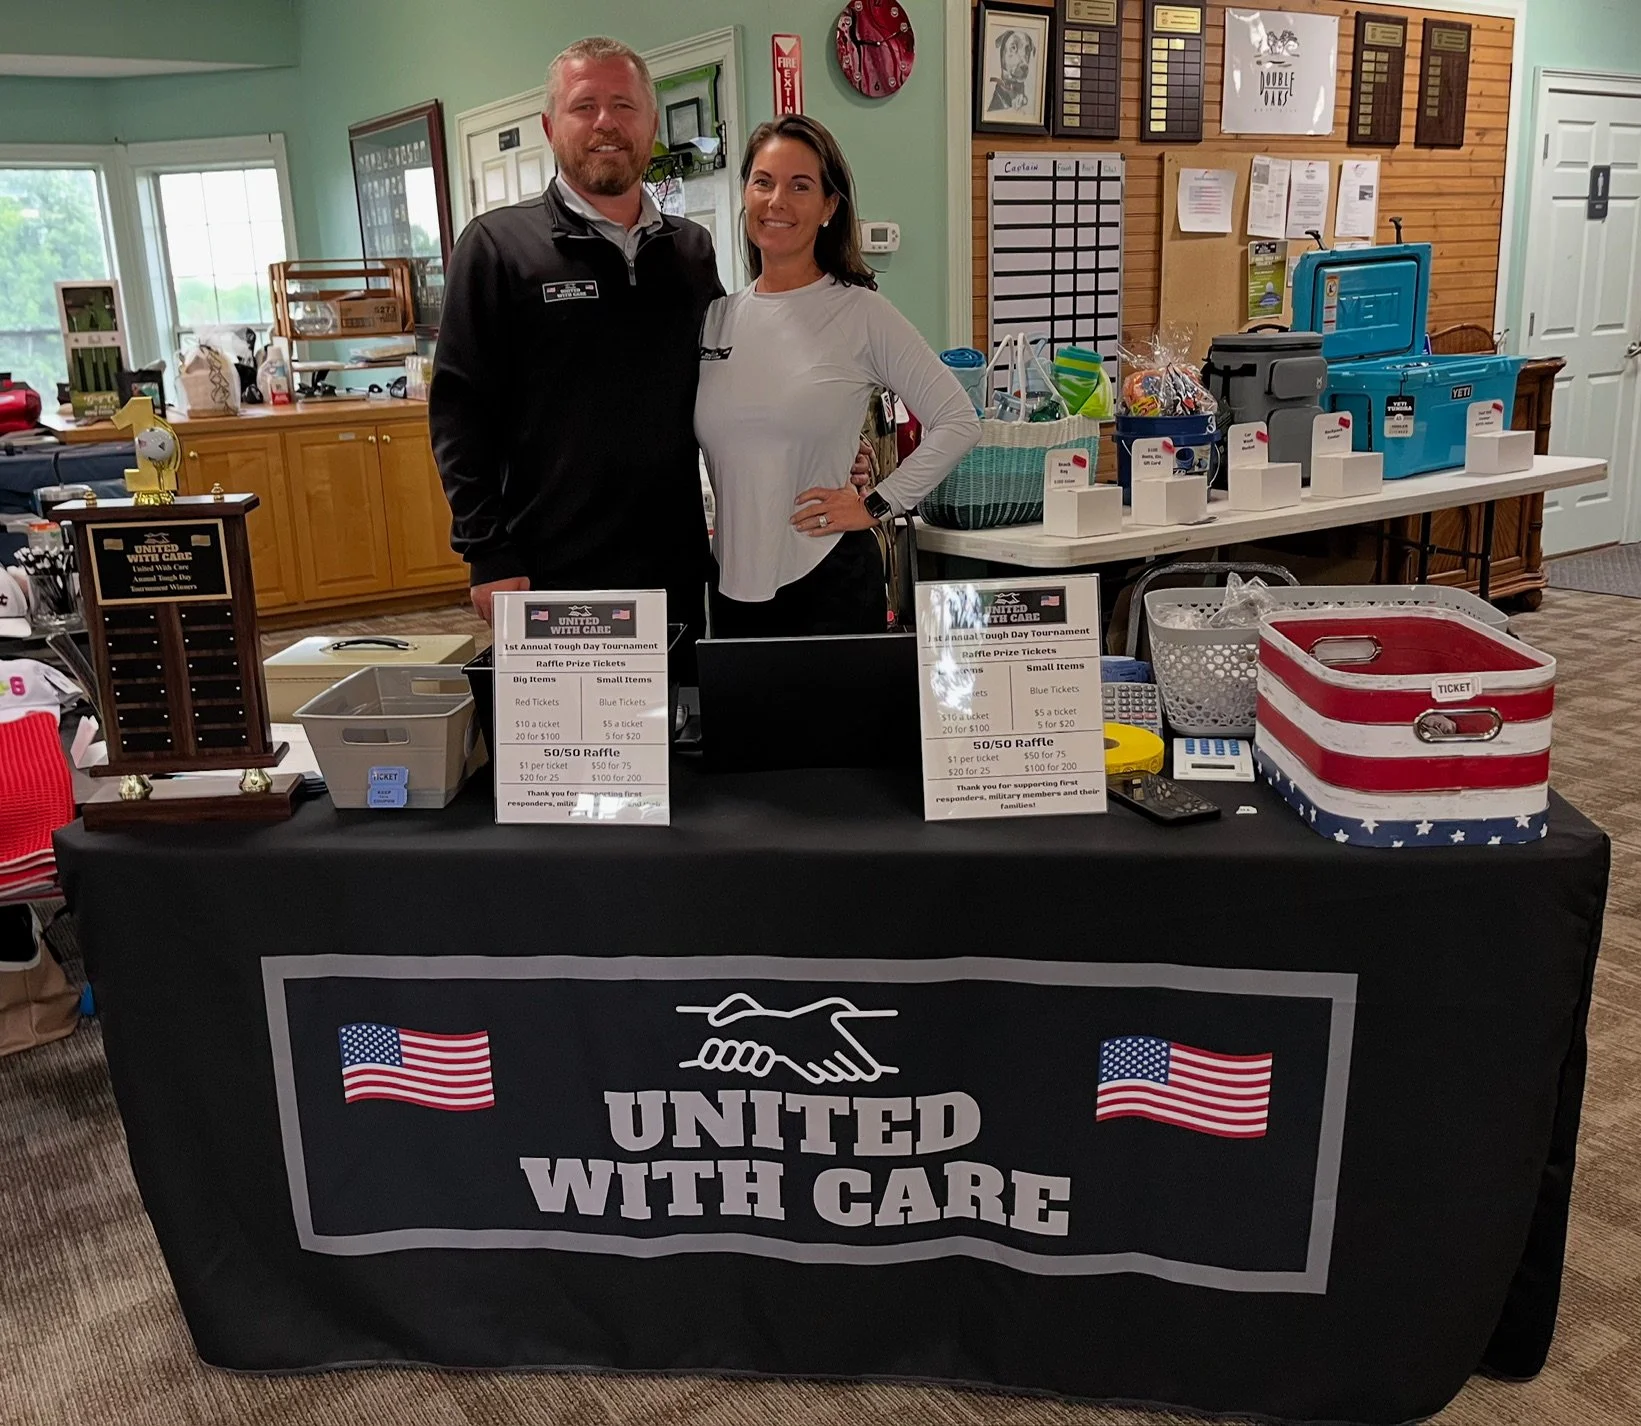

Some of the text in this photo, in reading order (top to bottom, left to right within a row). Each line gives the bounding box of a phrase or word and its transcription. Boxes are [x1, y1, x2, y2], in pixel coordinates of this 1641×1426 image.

[778, 56, 797, 68] FIRE
[874, 82, 880, 91] 6
[1260, 71, 1295, 96] DOUBLE
[1264, 90, 1289, 106] OAKS
[1004, 161, 1039, 174] Captain
[1452, 386, 1471, 398] YETI
[134, 543, 180, 554] UNITED
[126, 552, 193, 563] WITH CARE
[156, 564, 173, 572] With
[158, 574, 178, 582] Tough
[178, 574, 192, 582] Day
[984, 604, 1028, 614] UNITED
[558, 617, 600, 626] UNITED
[1010, 613, 1040, 622] CARE
[550, 626, 612, 635] WITH CARE
[944, 632, 978, 642] Annual
[980, 632, 1010, 640] Tough
[1011, 630, 1029, 640] Day
[1031, 628, 1090, 637] Tournament
[554, 643, 581, 651] Tough
[583, 642, 600, 651] Day
[602, 642, 658, 650] Tournament
[962, 647, 1057, 658] Raffle Prize Tickets
[536, 660, 564, 668] Raffle
[566, 660, 591, 668] Prize
[1026, 662, 1084, 672] Small Items
[513, 676, 528, 684] Big
[596, 676, 623, 684] Small
[1030, 685, 1080, 694] Blue Tickets
[1438, 682, 1471, 694] TICKET
[515, 698, 560, 706] Red Tickets
[599, 698, 646, 706] Blue Tickets
[1034, 708, 1045, 717] $5
[1054, 707, 1077, 716] ticket
[942, 713, 957, 722] $10
[966, 712, 990, 720] ticket
[515, 720, 530, 728] $10
[538, 720, 560, 728] ticket
[602, 720, 613, 728] $5
[621, 720, 644, 728] ticket
[1038, 720, 1075, 729] 5 for $20
[942, 724, 990, 734] 20 for $100
[526, 732, 539, 740] for
[540, 733, 560, 741] $100
[612, 732, 624, 740] for
[626, 732, 641, 741] $20
[973, 737, 1054, 750] 50/50 Raffle
[544, 748, 620, 757] 50/50 Raffle
[1024, 752, 1040, 760] $50
[1041, 751, 1054, 759] for
[948, 754, 1000, 764] $1 per ticket
[519, 762, 529, 770] $1
[547, 762, 568, 770] ticket
[592, 761, 632, 770] $50 for 75
[1024, 762, 1077, 773] $100 for 200
[948, 768, 964, 776] $20
[965, 767, 978, 775] for
[373, 773, 398, 781] TICKET
[519, 774, 534, 782] $20
[592, 774, 612, 782] $100
[1014, 780, 1058, 789] supporting
[936, 795, 987, 803] responders,
[988, 792, 1021, 801] military
[1022, 791, 1061, 799] members
[1079, 788, 1100, 796] their
[1000, 802, 1036, 810] families!
[604, 1090, 982, 1156] UNITED
[520, 1157, 1072, 1237] WITH CARE
